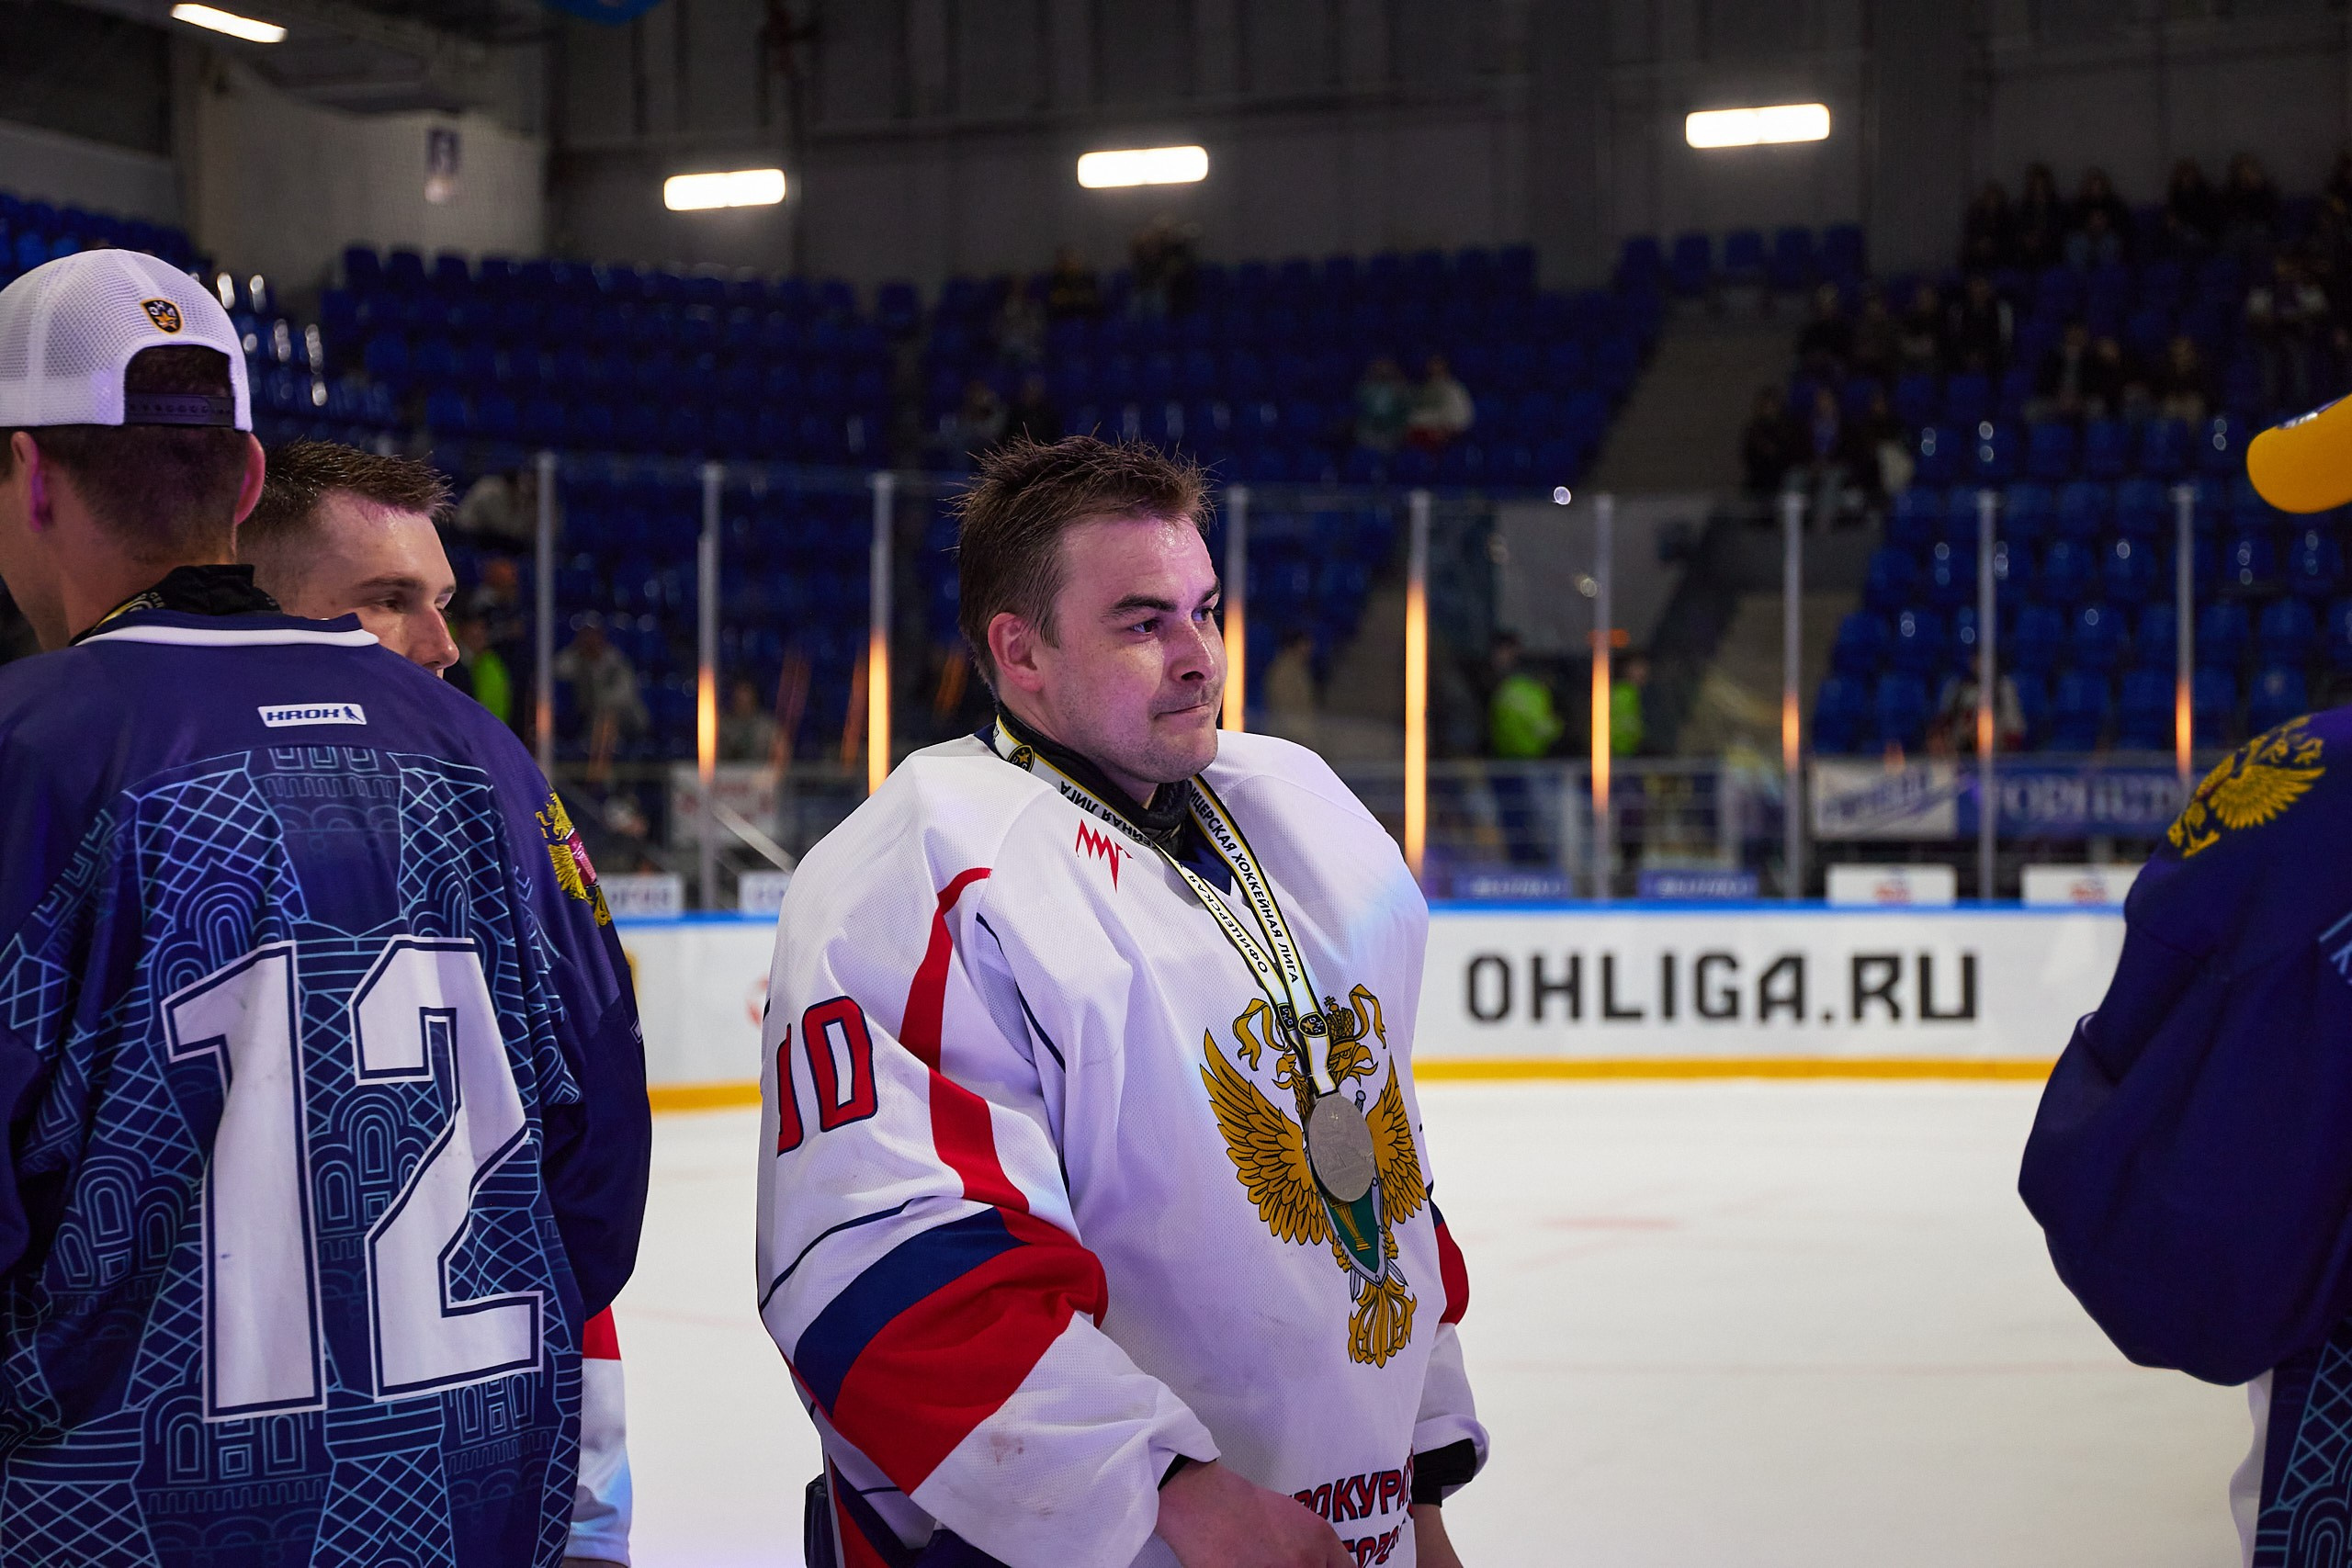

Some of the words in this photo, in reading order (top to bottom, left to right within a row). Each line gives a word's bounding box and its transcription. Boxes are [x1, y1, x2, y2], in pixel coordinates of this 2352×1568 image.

[1188, 874, 1269, 973] ОФИЦЕРСКАЯ
[1231, 852, 1283, 938] ХОККЕЙНАЯ
[1278, 942, 1299, 983] ЛИГА
[1467, 953, 1976, 1021] OHLIGA.RU
[161, 935, 543, 1423] 12
